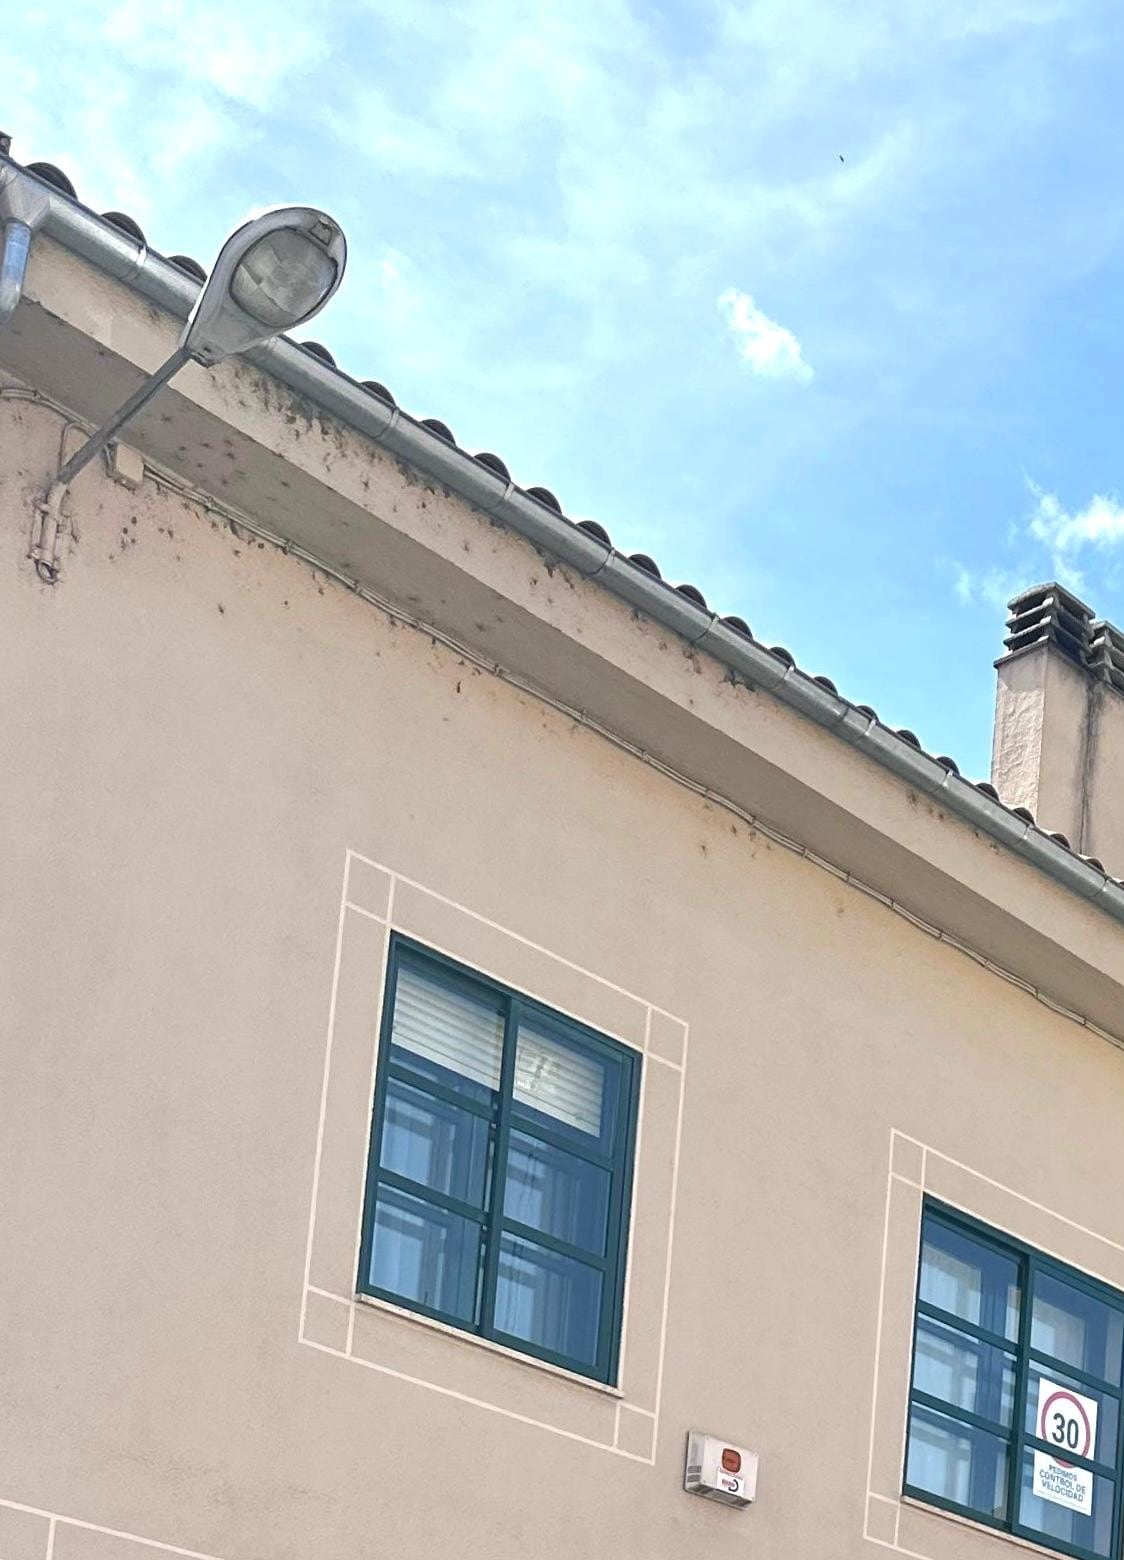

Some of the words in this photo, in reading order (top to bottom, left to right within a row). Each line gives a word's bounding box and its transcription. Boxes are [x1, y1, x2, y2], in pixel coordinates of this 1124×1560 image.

[1052, 1412, 1079, 1449] 30
[1039, 1469, 1074, 1490] CONTROL
[1075, 1483, 1087, 1495] DE
[1041, 1479, 1084, 1503] VELOCIDAD
